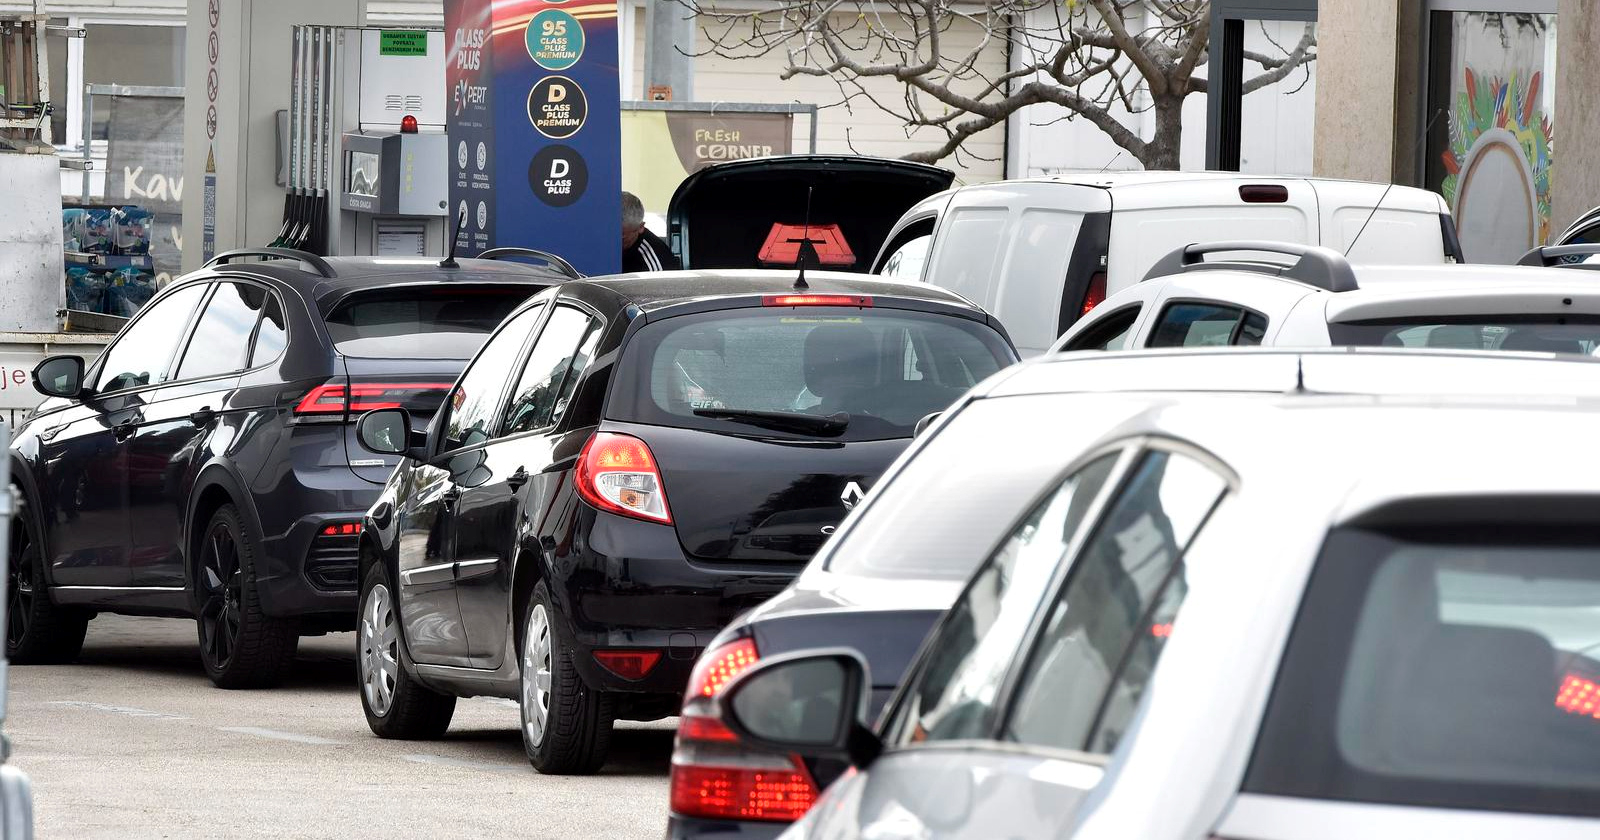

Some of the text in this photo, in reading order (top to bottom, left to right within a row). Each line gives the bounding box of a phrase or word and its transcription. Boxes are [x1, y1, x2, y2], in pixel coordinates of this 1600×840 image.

[542, 20, 567, 36] 95
[455, 28, 484, 48] CLASS
[540, 37, 568, 45] CLASS
[457, 50, 480, 71] PLUS
[536, 51, 577, 59] PREMIUM
[548, 84, 567, 103] D
[542, 104, 571, 112] CLASS
[546, 111, 570, 119] PLUS
[537, 118, 580, 127] PREMIUM
[696, 129, 740, 142] FRESH
[696, 144, 772, 159] CORNER
[550, 159, 570, 178] D
[544, 179, 572, 187] CLASS
